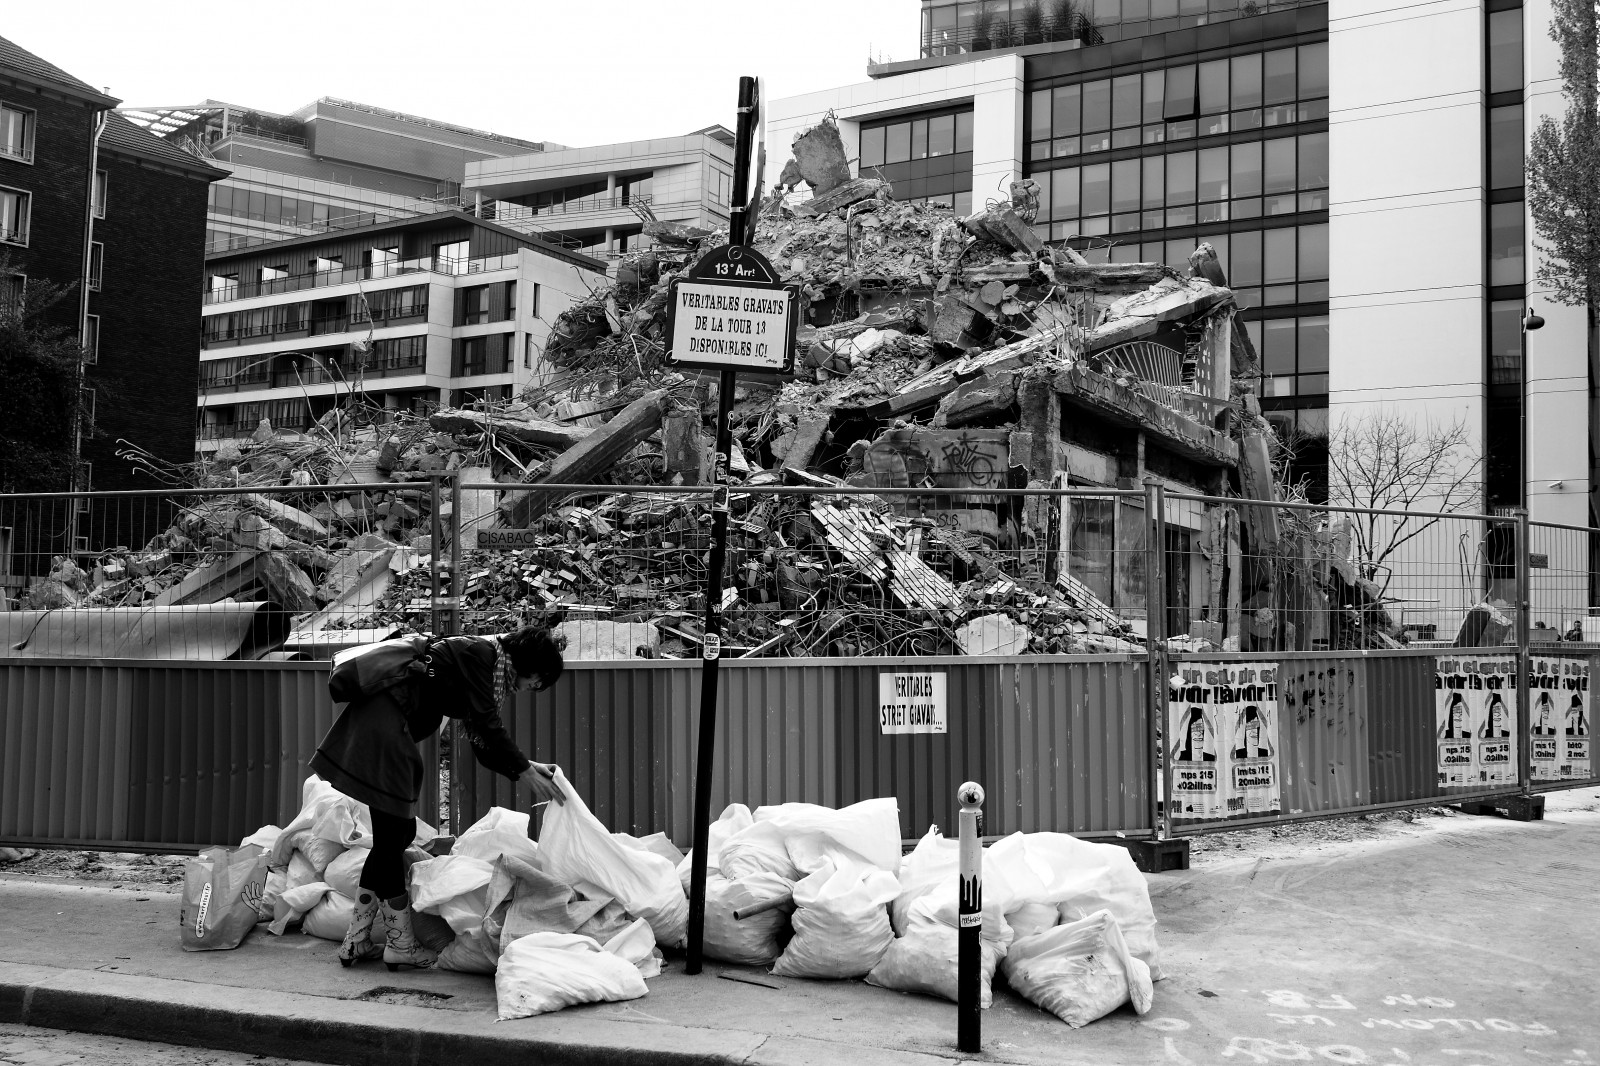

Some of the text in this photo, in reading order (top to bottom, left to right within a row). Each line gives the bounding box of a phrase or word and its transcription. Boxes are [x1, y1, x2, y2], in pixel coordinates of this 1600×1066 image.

[743, 297, 784, 315] GRAVATS
[694, 315, 707, 331] DE
[711, 317, 723, 332] LA
[728, 318, 751, 335] TOUR
[689, 337, 752, 357] DISPONIBLES
